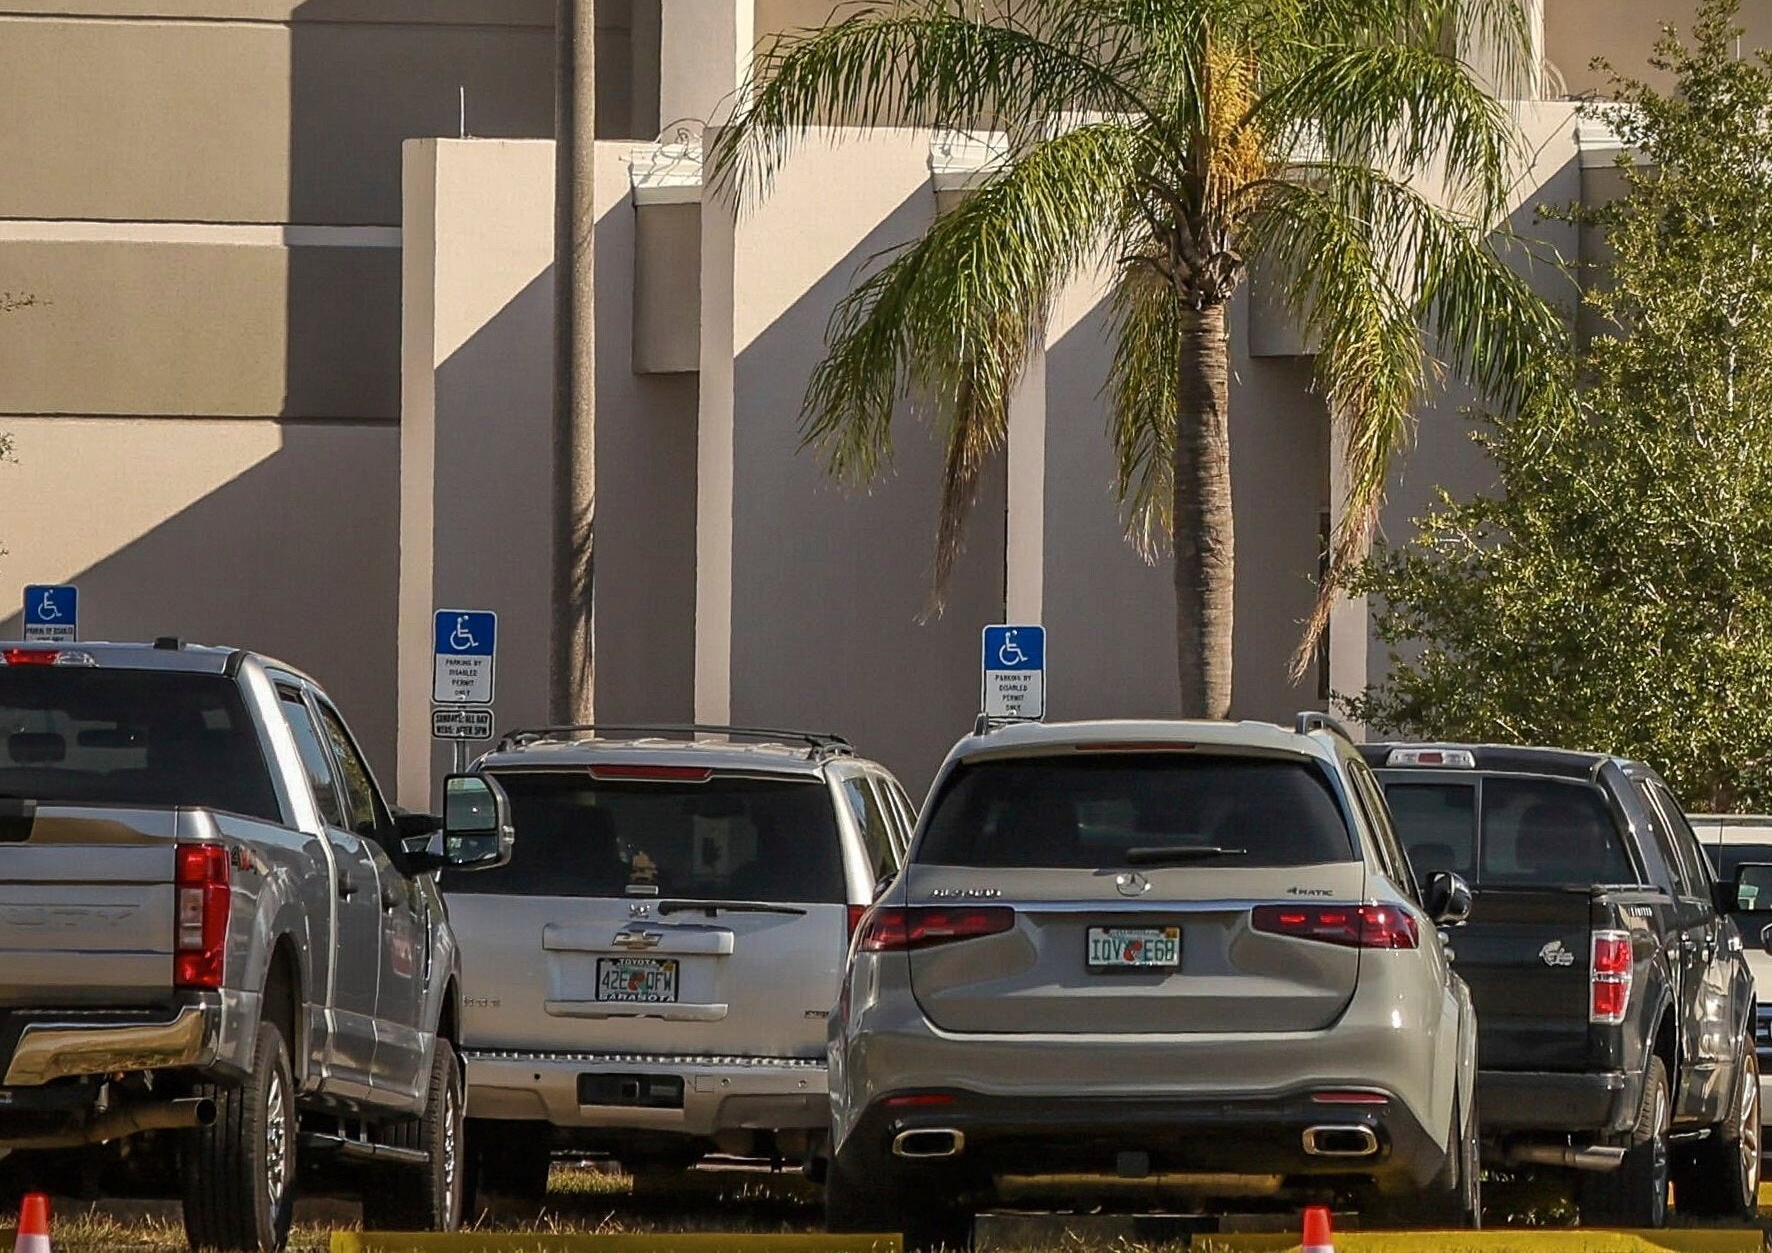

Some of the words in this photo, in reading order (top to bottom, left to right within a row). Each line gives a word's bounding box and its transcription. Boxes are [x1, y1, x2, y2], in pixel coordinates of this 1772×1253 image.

[445, 658, 472, 666] PARKING
[465, 715, 475, 723] ALL
[477, 715, 488, 724] DAY
[474, 726, 487, 735] 5PM
